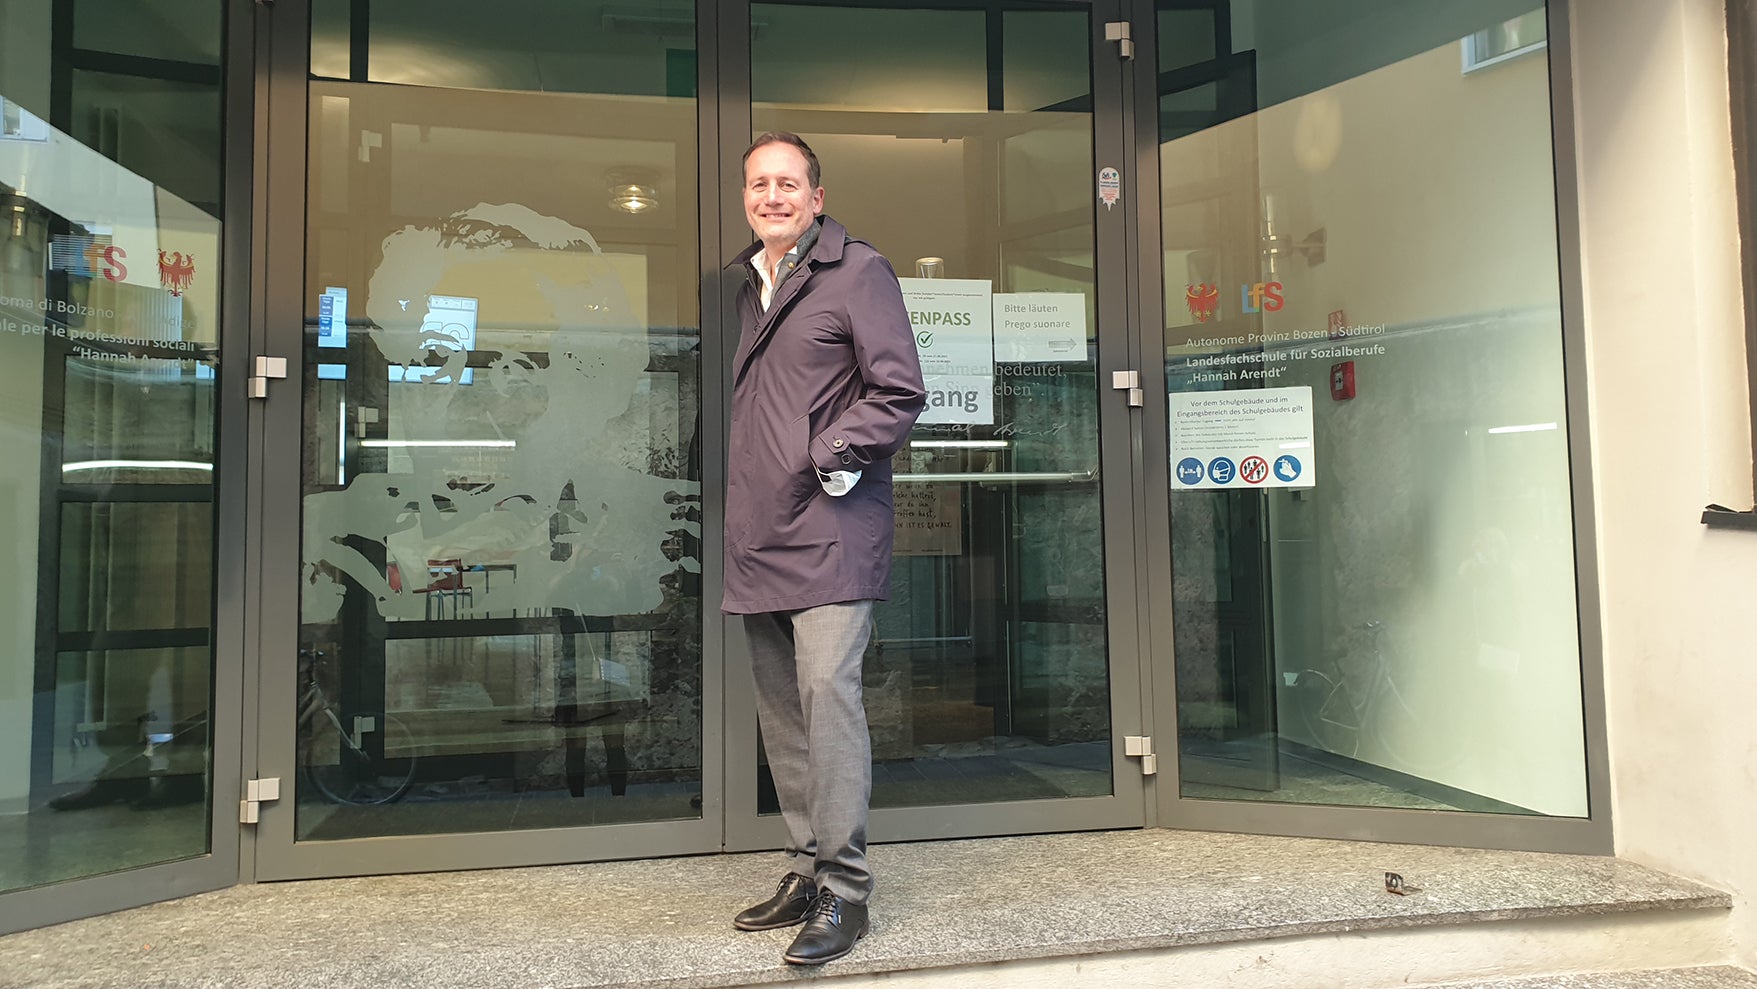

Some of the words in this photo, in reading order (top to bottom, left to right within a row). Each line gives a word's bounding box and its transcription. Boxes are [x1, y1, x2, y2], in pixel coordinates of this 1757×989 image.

[1241, 281, 1285, 314] LfS
[38, 298, 52, 311] di
[57, 300, 114, 318] Bolzano
[1004, 304, 1027, 313] Bitte
[1028, 303, 1058, 313] läuten
[906, 311, 971, 326] ENPASS
[1004, 320, 1031, 331] Prego
[21, 323, 48, 336] per
[52, 323, 66, 337] le
[70, 328, 149, 347] professioni
[153, 337, 195, 352] sociali
[1185, 335, 1245, 348] Autonome
[1248, 331, 1290, 343] Provinz
[1293, 329, 1328, 340] Bozen
[1338, 323, 1385, 337] Südtirol
[141, 354, 194, 370] Adt”
[1186, 350, 1287, 367] Landesfachschule
[1290, 349, 1308, 361] für
[1310, 344, 1386, 359] Sozialberufe
[994, 362, 1067, 379] bedeutet,
[1186, 370, 1237, 385] „Hannah
[1240, 366, 1287, 380] Arendt“
[1203, 399, 1218, 407] dem
[1219, 397, 1265, 408] Schulgebäude
[1265, 396, 1278, 404] und
[1176, 409, 1228, 418] Eingangsbereich
[1229, 407, 1241, 416] des
[1241, 406, 1291, 416] Schulgebäudes
[1291, 405, 1304, 414] gilt
